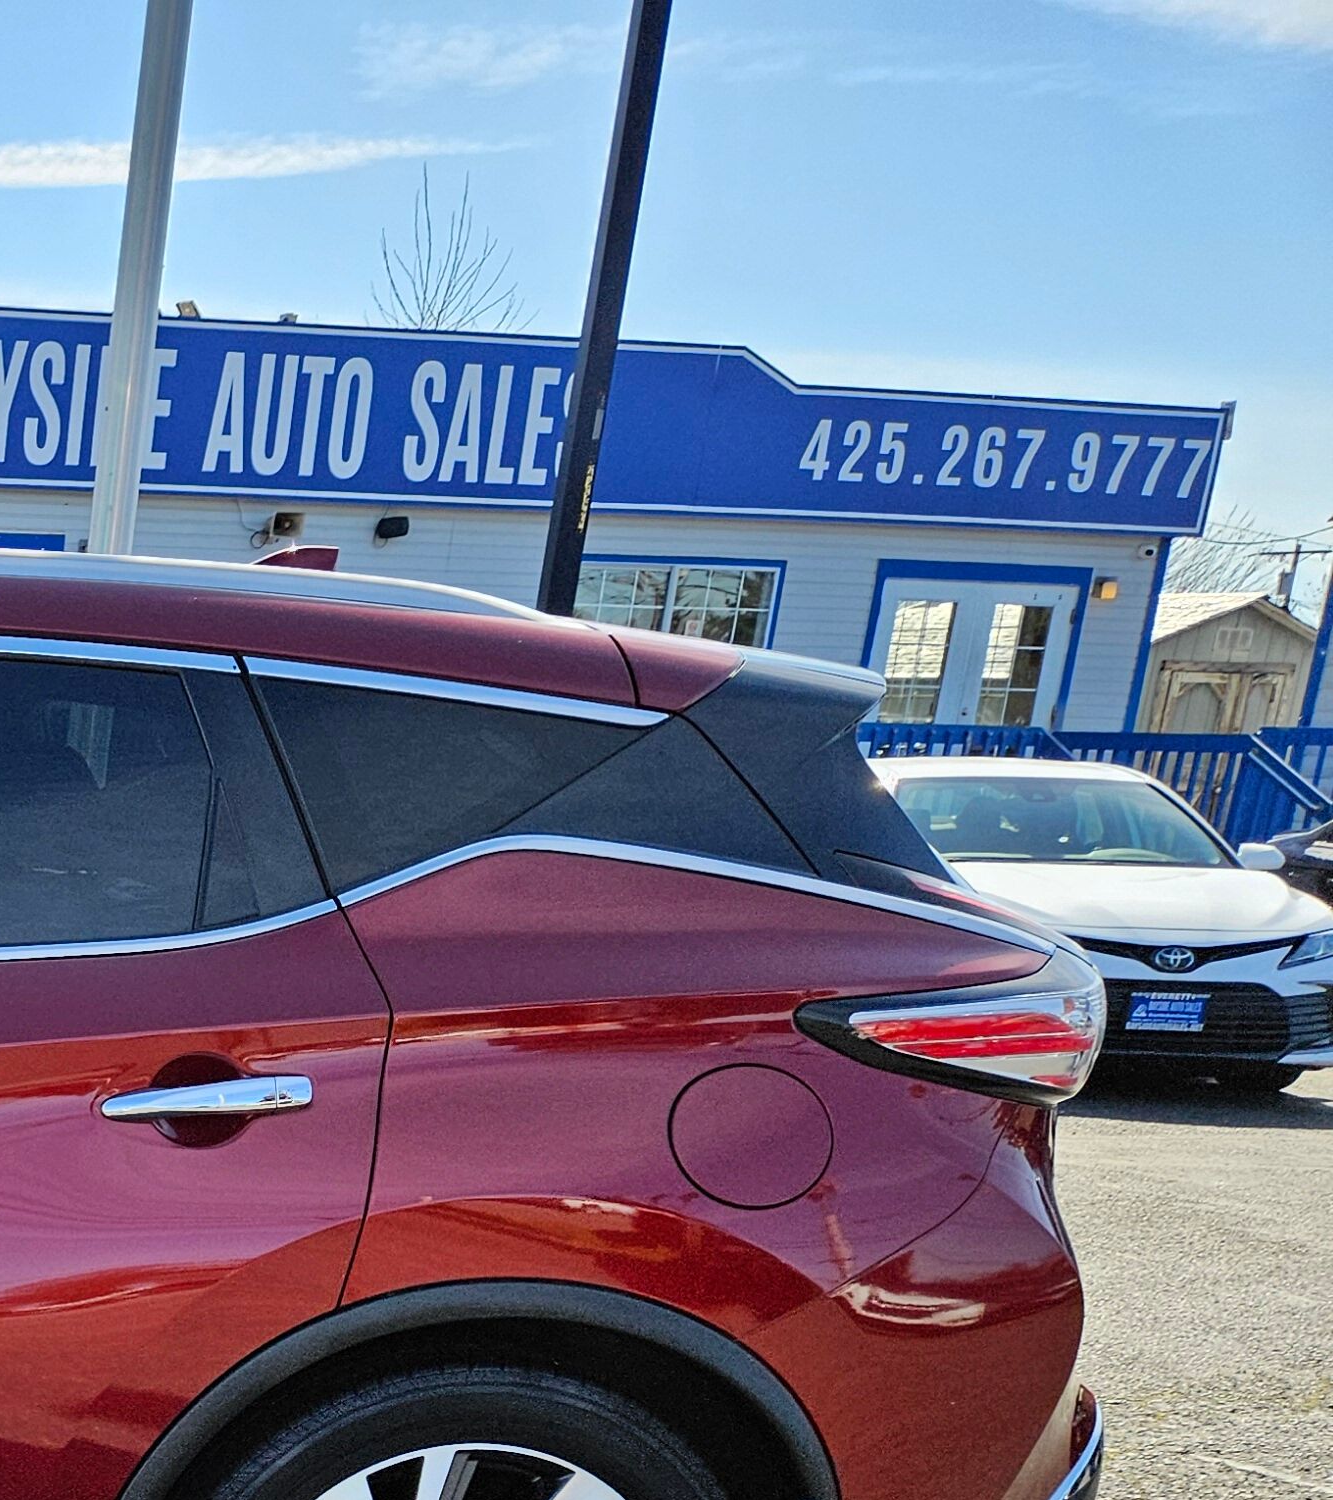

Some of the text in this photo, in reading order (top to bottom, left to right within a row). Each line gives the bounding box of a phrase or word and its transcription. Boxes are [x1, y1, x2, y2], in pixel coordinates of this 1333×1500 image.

[200, 351, 375, 480] AUTO
[402, 359, 576, 487] SALE
[798, 418, 1212, 499] 425.267.9777
